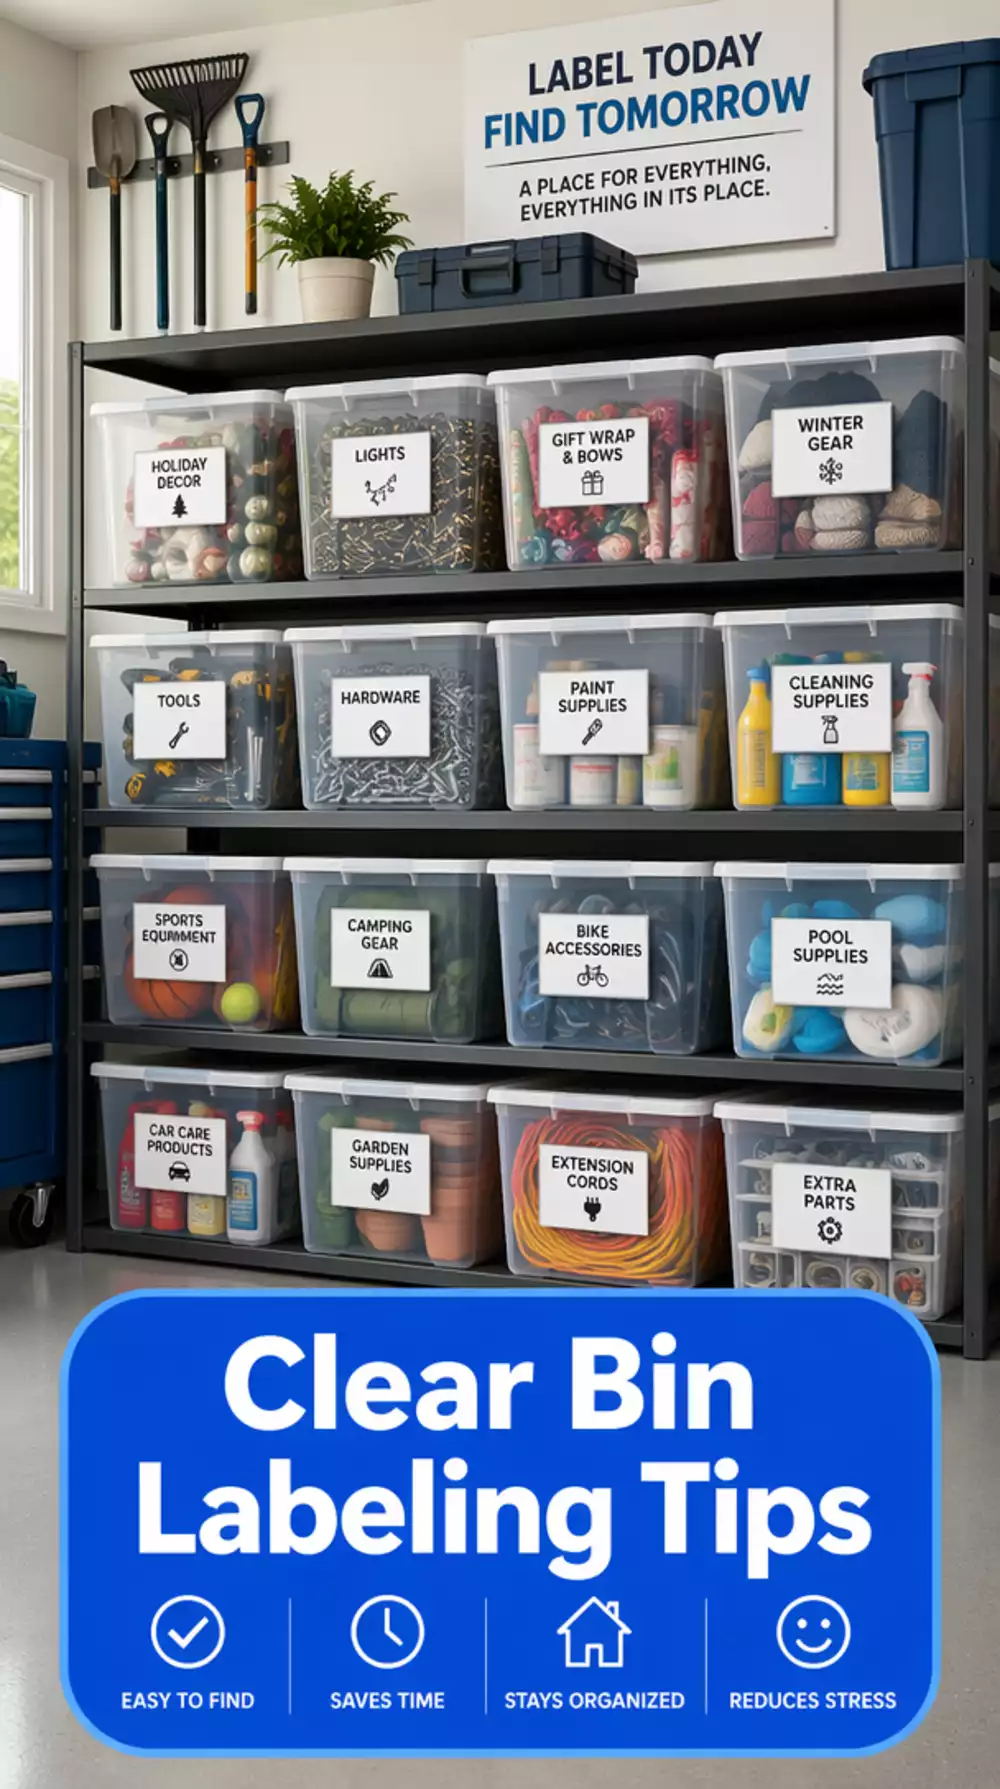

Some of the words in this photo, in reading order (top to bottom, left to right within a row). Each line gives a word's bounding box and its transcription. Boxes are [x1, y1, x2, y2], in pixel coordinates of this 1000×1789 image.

[529, 51, 633, 95] LABEL
[643, 31, 762, 79] TODAY
[485, 108, 565, 149] FIND
[577, 74, 810, 137] TOMORROW
[519, 181, 532, 197] A
[538, 173, 594, 195] PLACE
[602, 168, 637, 188] FOR
[645, 154, 770, 183] EVERYTHING,
[521, 193, 637, 221] EVERYTHING
[644, 190, 662, 208] IN
[670, 186, 697, 205] ITS
[704, 179, 770, 201] PLACE.
[798, 416, 863, 432] WINTER
[552, 432, 585, 447] GIFT
[590, 429, 635, 444] WRAP
[808, 435, 853, 451] GEAR
[356, 446, 405, 462] LIGHTS
[563, 451, 573, 464] &
[578, 448, 622, 464] BOWS
[152, 458, 207, 472] HOLIDAY
[158, 474, 201, 489] DECOR
[571, 681, 614, 695] PAINT
[789, 674, 873, 690] CLEANING
[157, 694, 200, 707] TOOLS
[342, 690, 420, 704] HARDWARE
[559, 698, 627, 712] SUPPLIES
[794, 694, 868, 708] SUPPLIES
[156, 913, 203, 927] SPORTS
[348, 919, 412, 933] CAMPING
[577, 924, 609, 939] BIKE
[809, 930, 853, 944] POOL
[362, 936, 398, 950] GEAR
[546, 942, 642, 957] ACCESSORIES
[794, 948, 868, 964] SUPPLIES
[150, 1124, 174, 1137] CAR
[178, 1126, 210, 1141] CARE
[148, 1140, 212, 1156] PRODUCTS
[352, 1139, 408, 1156] GARDEN
[350, 1156, 411, 1173] SUPPLIES
[552, 1155, 633, 1174] EXTENSION
[567, 1174, 618, 1191] CORDS
[804, 1175, 856, 1192] EXTRA
[805, 1194, 855, 1211] PARTS
